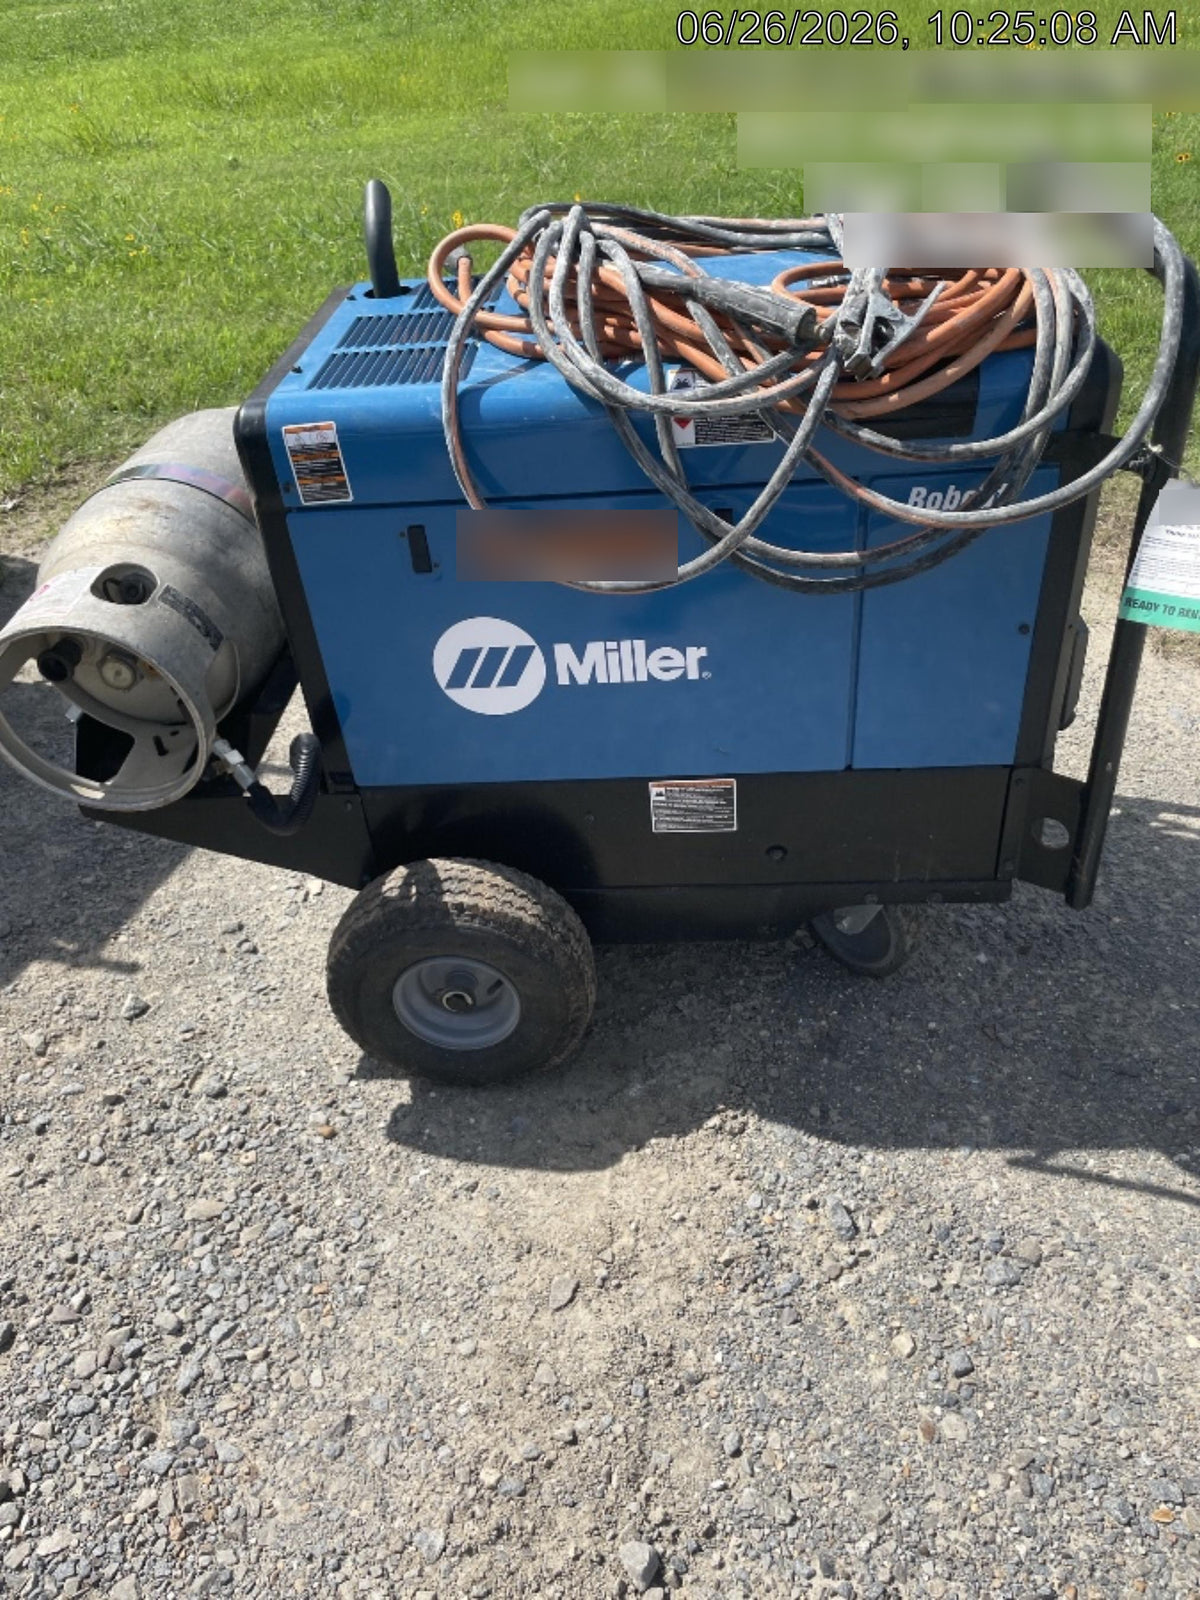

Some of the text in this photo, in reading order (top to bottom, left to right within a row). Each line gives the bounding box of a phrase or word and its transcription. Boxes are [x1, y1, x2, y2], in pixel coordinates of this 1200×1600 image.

[1124, 597, 1200, 620] READY TO REN
[553, 639, 709, 686] Miller
